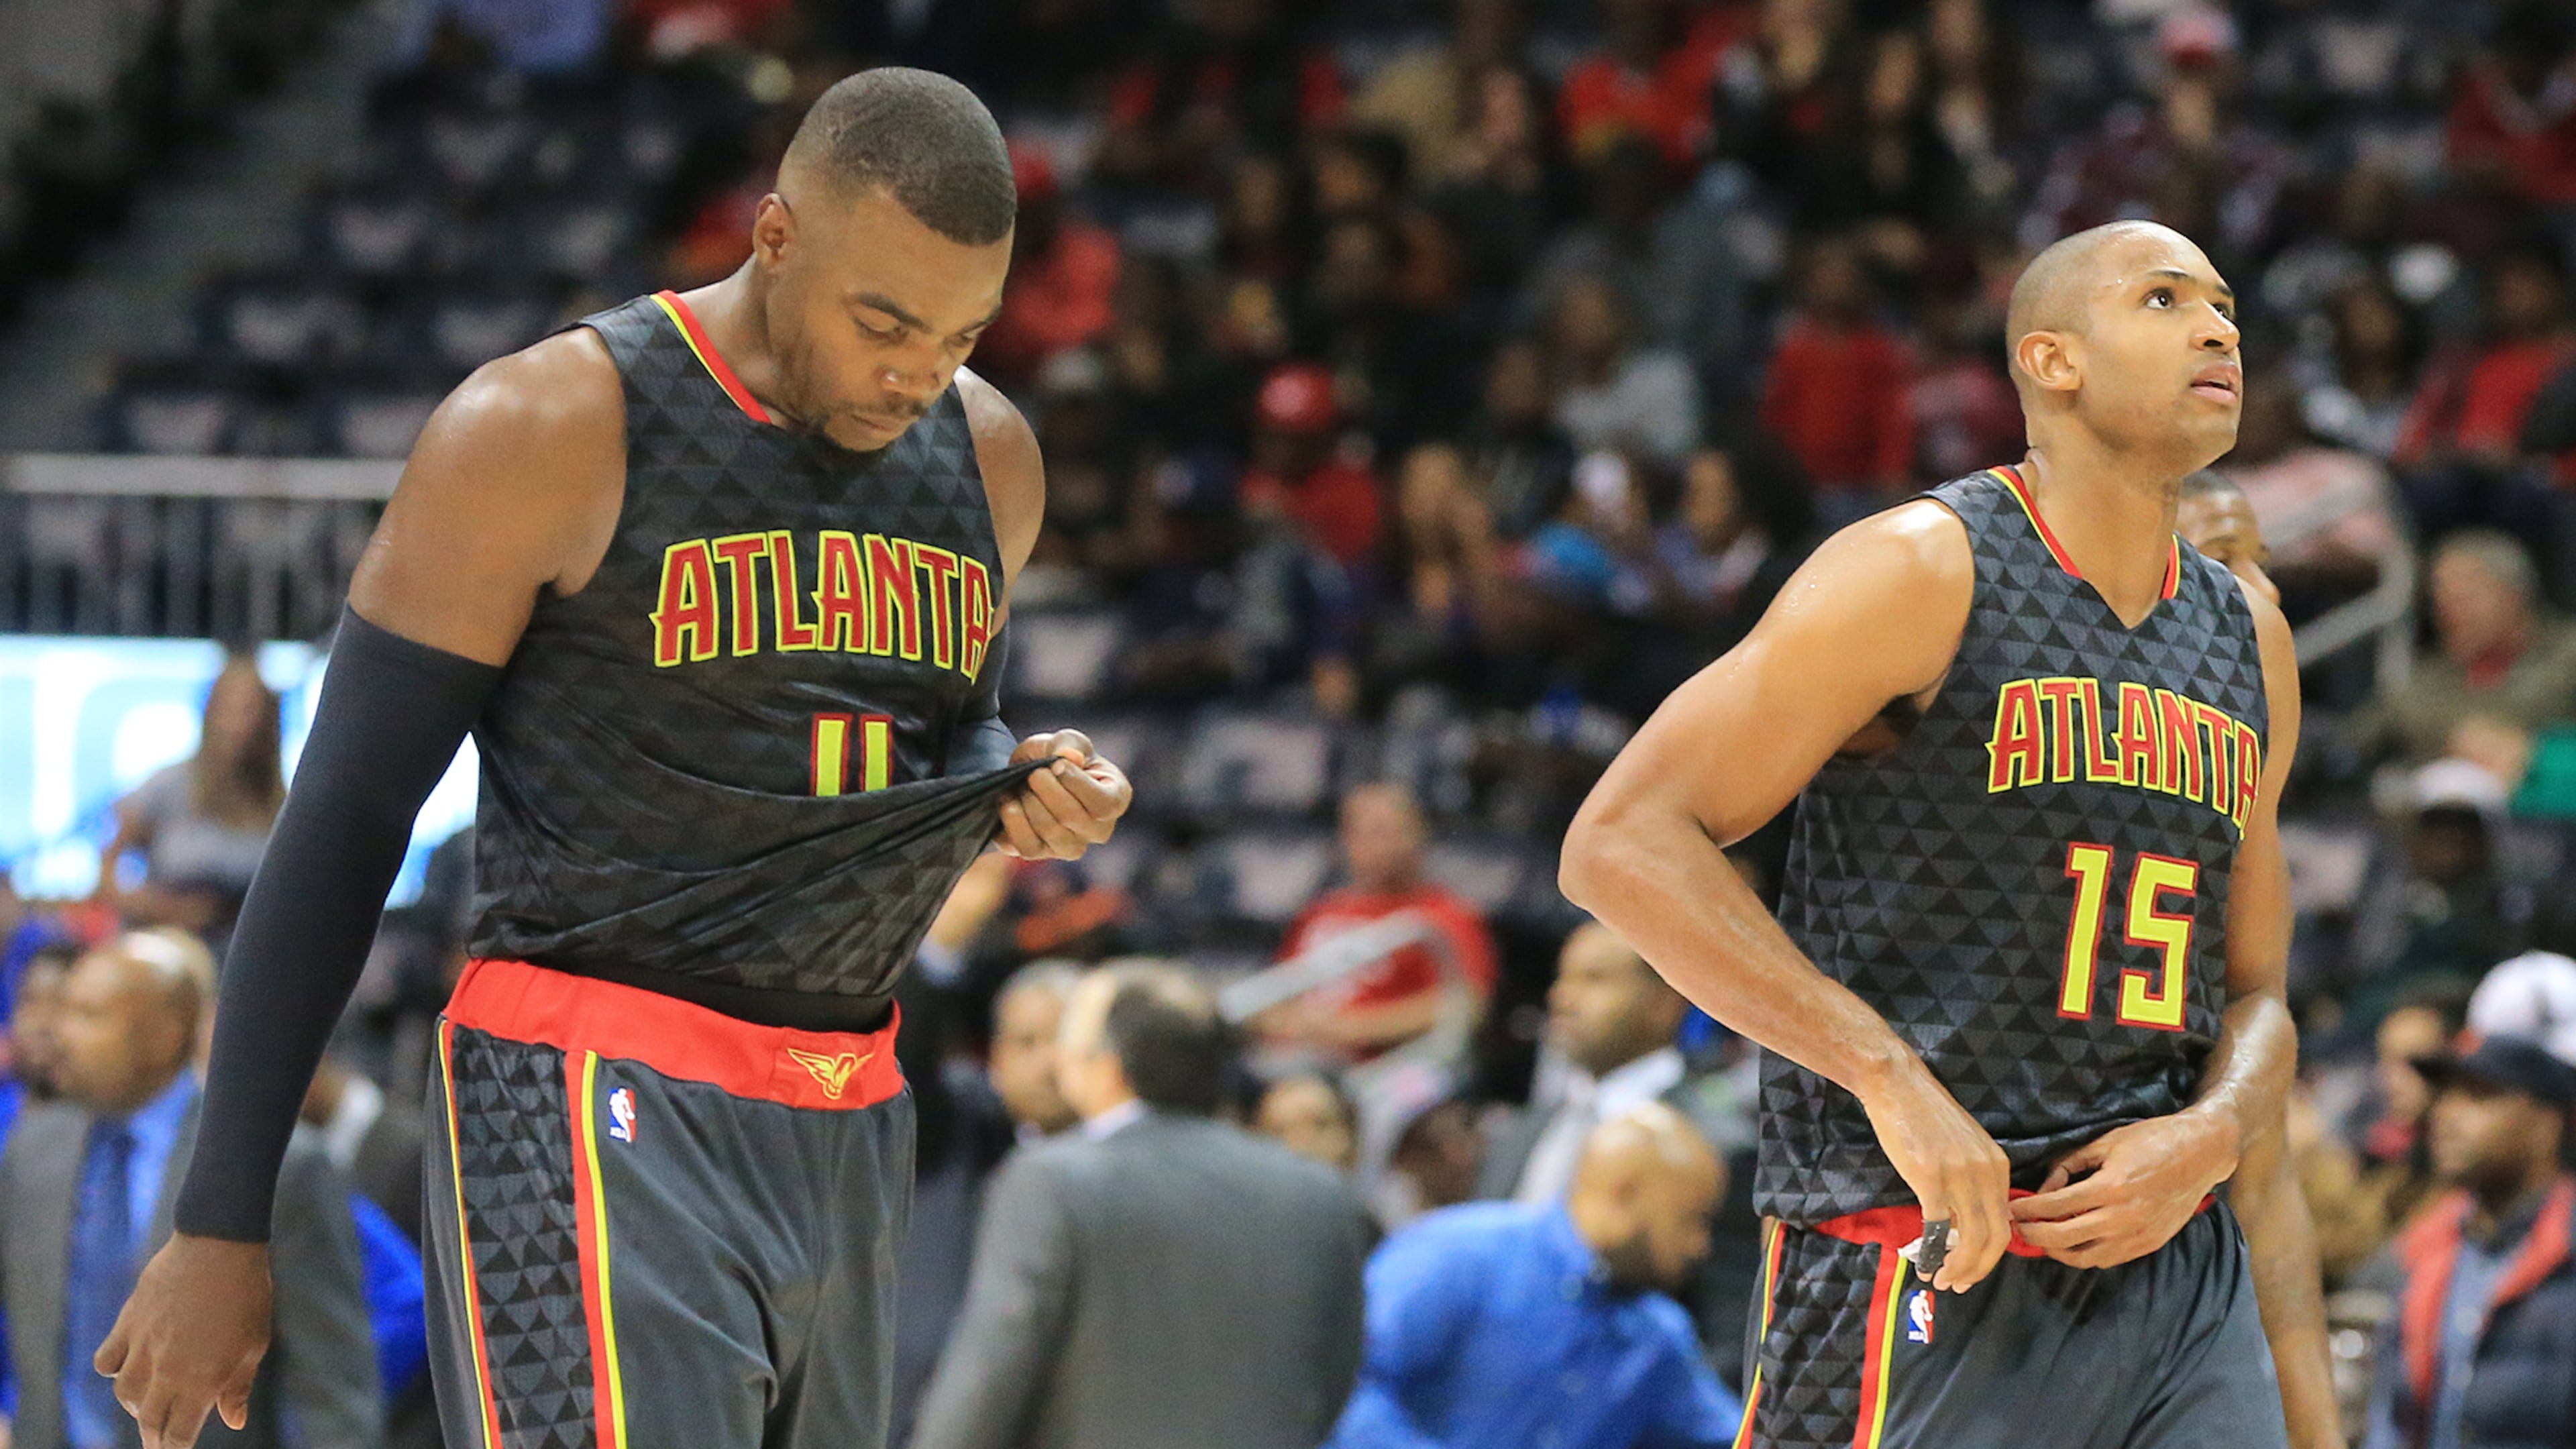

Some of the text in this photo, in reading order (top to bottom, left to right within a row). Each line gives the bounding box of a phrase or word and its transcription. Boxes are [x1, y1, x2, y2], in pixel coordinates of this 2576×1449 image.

[649, 529, 994, 686] ATLANTA
[1984, 677, 2260, 841] ATLANTA
[2057, 842, 2198, 1031] 15
